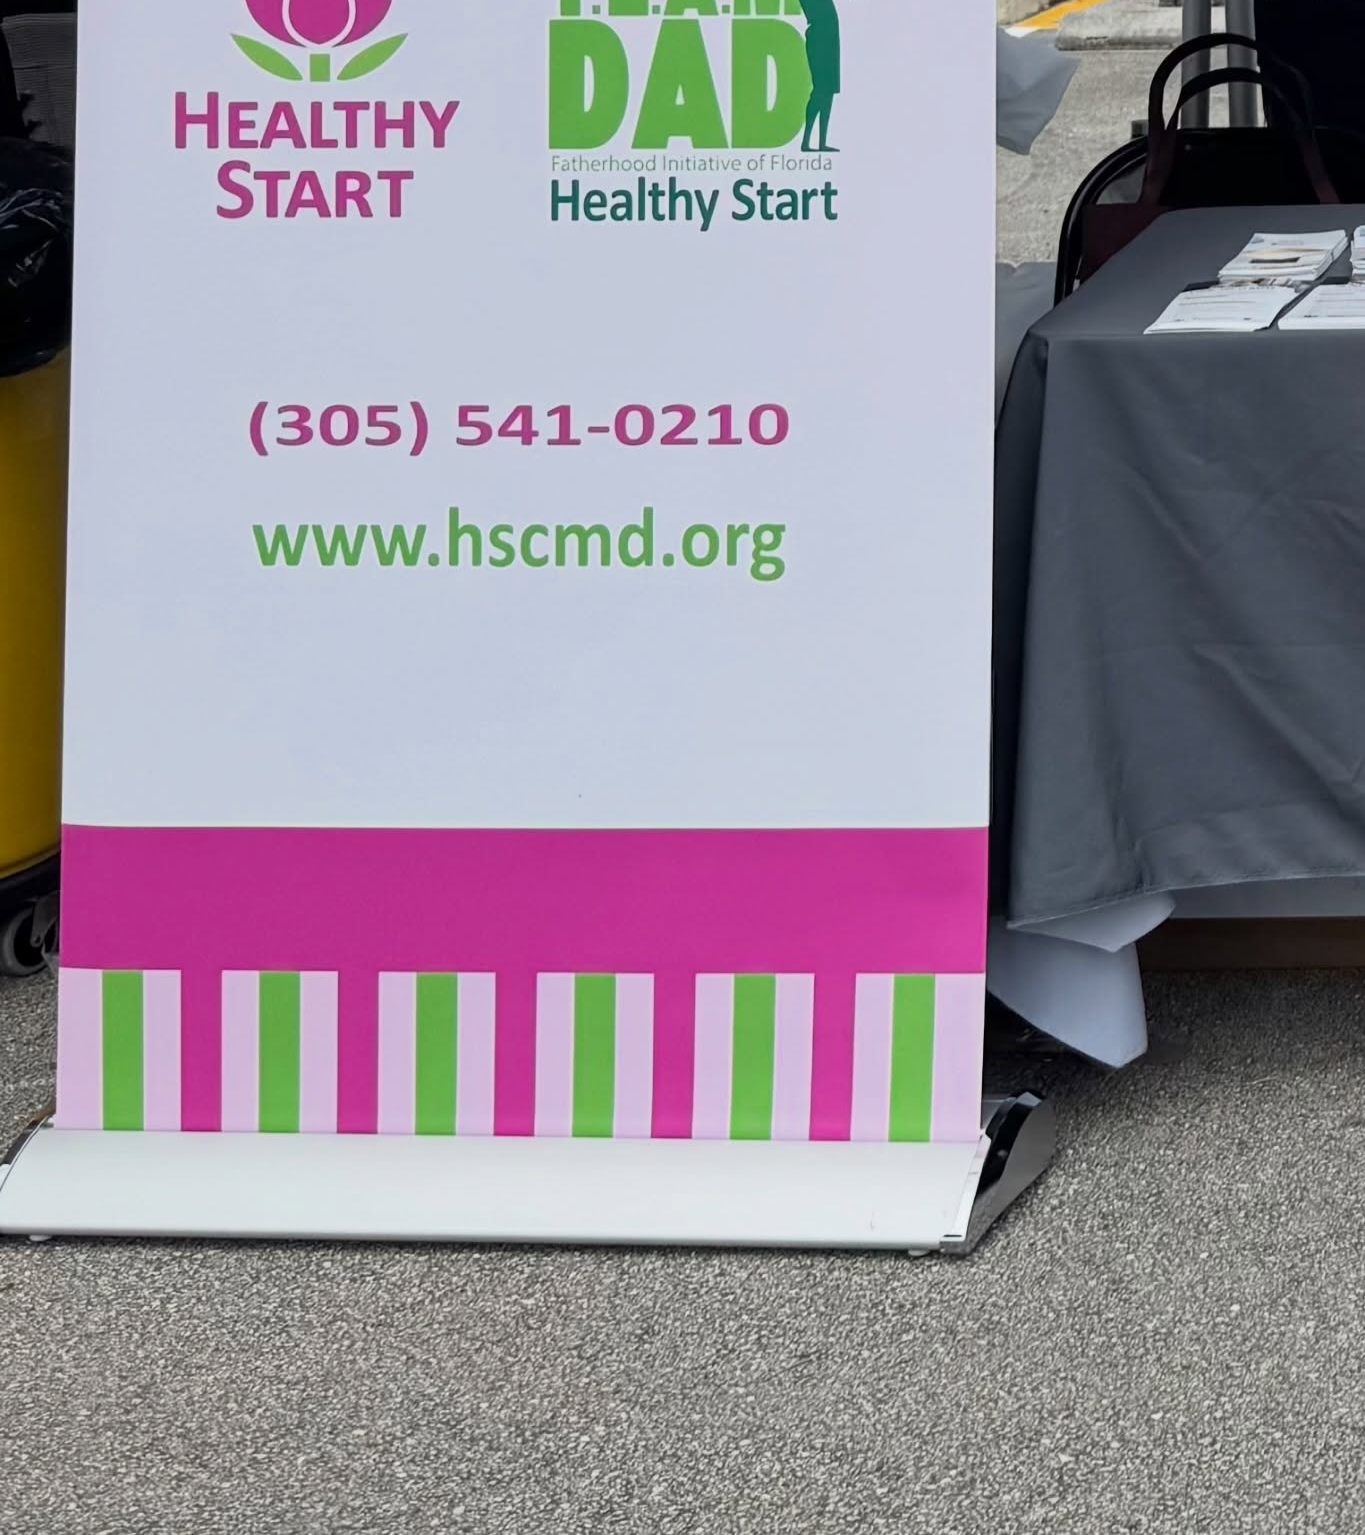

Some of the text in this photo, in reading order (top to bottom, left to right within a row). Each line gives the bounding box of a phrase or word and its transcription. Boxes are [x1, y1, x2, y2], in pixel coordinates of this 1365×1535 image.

[549, 18, 813, 150] DAD
[174, 91, 460, 150] HEALTHY
[216, 160, 414, 220] START
[552, 154, 831, 171] Fatherhood Initiative of Florida
[551, 176, 838, 232] Healthy Start
[249, 401, 790, 457] (305) 541-0210
[252, 506, 786, 583] www.hscmd.org
